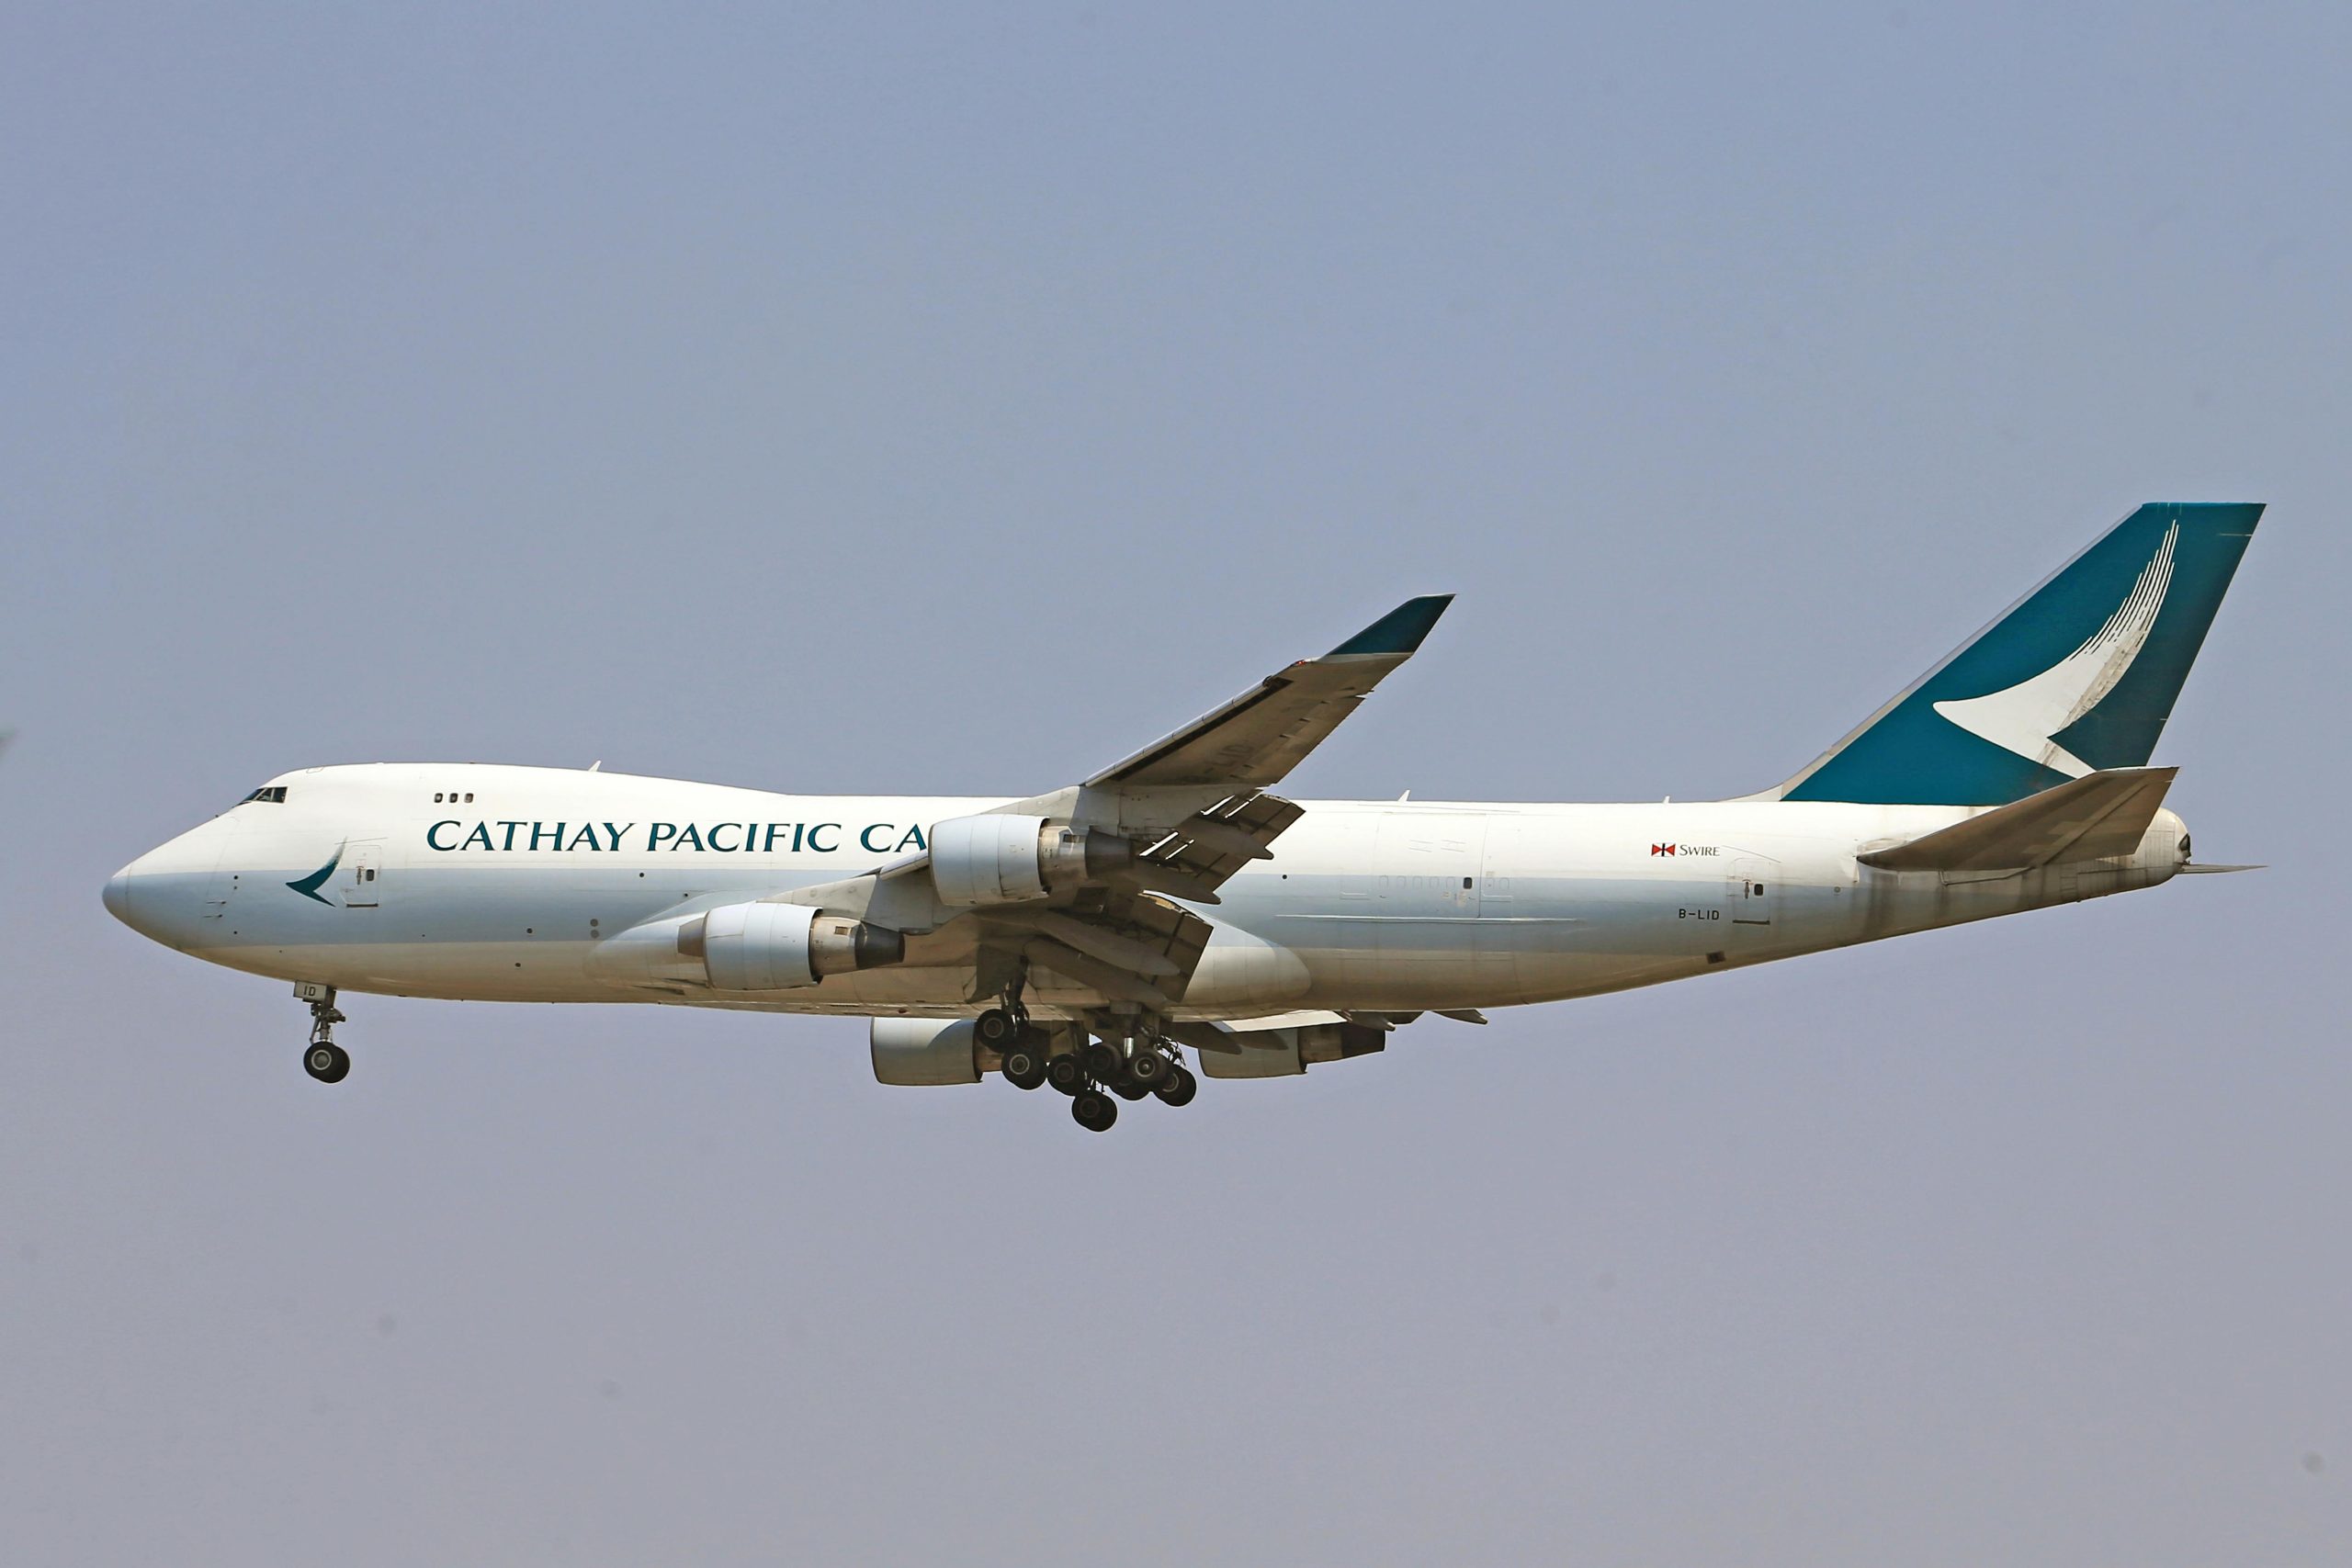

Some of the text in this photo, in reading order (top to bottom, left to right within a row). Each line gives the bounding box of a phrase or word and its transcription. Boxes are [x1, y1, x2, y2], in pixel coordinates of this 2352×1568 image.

[426, 819, 927, 853] CATHAY PACIFIC CA
[1679, 908, 1720, 920] B-LID
[303, 985, 316, 997] ID
